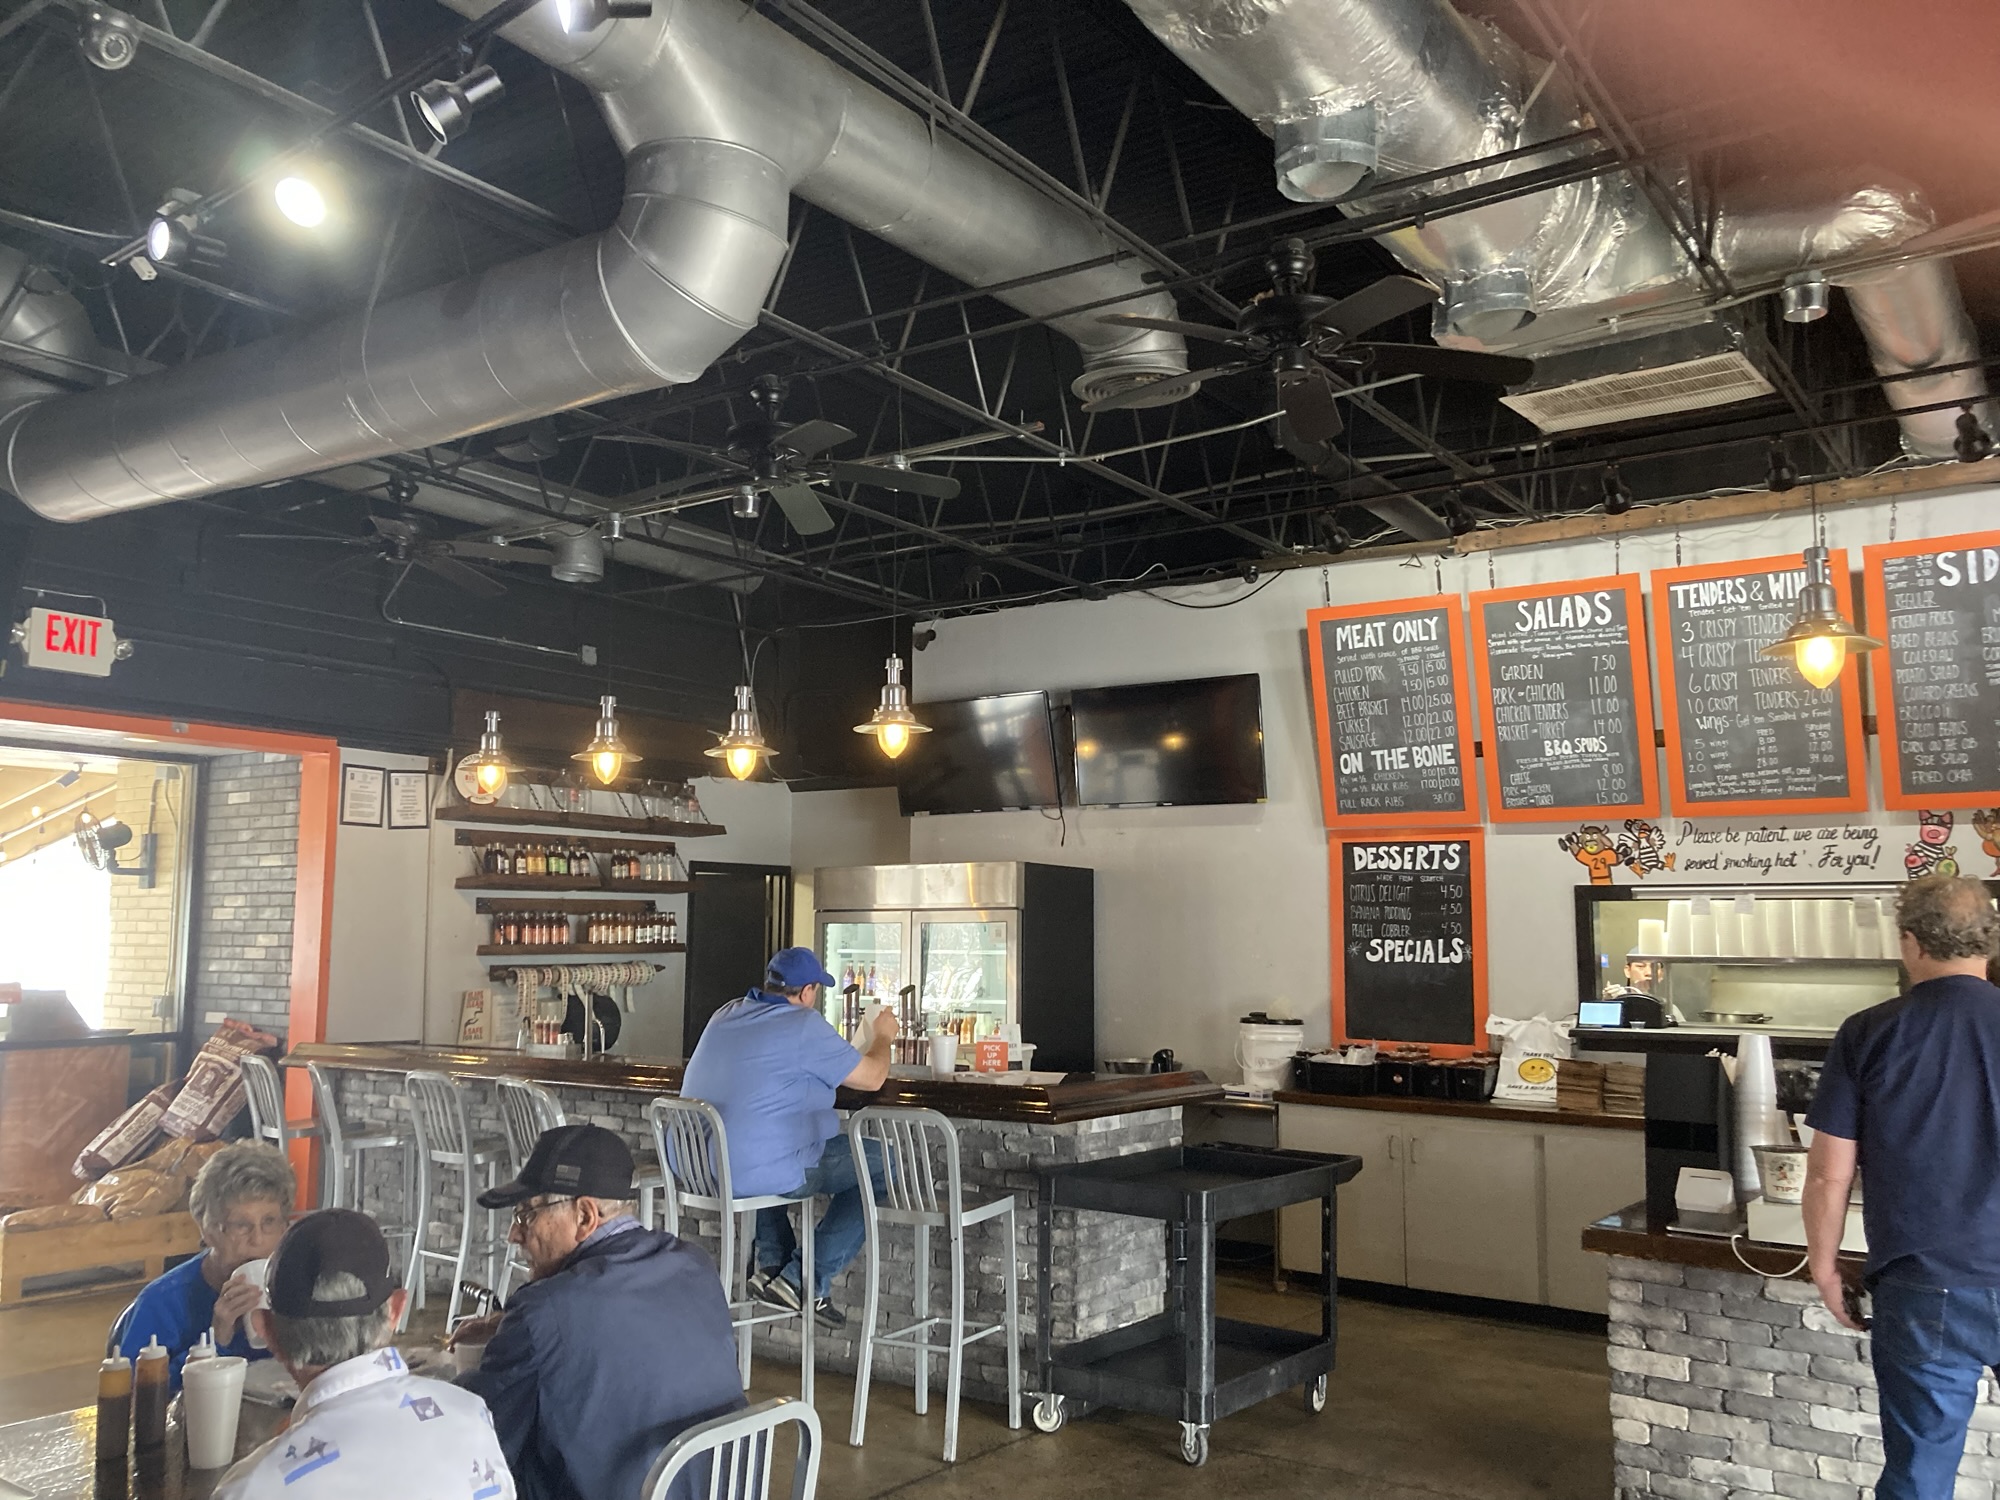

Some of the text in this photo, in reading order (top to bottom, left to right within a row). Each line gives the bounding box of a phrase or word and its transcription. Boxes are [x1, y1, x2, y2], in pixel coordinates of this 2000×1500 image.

[1670, 578, 1747, 609] TENDERS
[1750, 580, 1764, 601] &
[1515, 592, 1612, 632] SALADS
[45, 614, 102, 657] EXIT
[1336, 616, 1438, 651] MEAT ONLY
[1681, 613, 1793, 642] 3 CRISPY TENDERS
[1681, 640, 1737, 668] 4 CRISPY
[1335, 667, 1362, 684] PULLED
[1365, 665, 1385, 682] PORK
[1501, 654, 1616, 681] GARDEN 7.50
[1688, 667, 1792, 693] 6 CRISPY TENDERS
[1333, 685, 1369, 703] CHICKEN
[1493, 687, 1516, 705] PORK
[1526, 682, 1565, 702] CHICKEN
[1687, 698, 1704, 714] 10
[1707, 695, 1739, 712] CRISPY
[1753, 691, 1800, 710] TENDERS
[1336, 702, 1355, 720] BEEF
[1358, 699, 1388, 716] BRISKET
[1495, 704, 1531, 724] CHICKEN
[1533, 702, 1569, 721] TENDERS
[1336, 716, 1370, 735] TURKEY
[1497, 723, 1530, 742] BRISKET
[1538, 720, 1566, 739] TURKEY
[1339, 732, 1379, 751] SAUSAGE
[1544, 736, 1608, 756] BBQ SPUDS
[1695, 738, 1705, 749] 5
[1709, 740, 1729, 748] wings
[1340, 744, 1456, 775] ON THE BONE
[1688, 751, 1704, 761] 10
[1710, 751, 1729, 759] wings
[1374, 772, 1405, 781] CHICKEN
[1510, 771, 1531, 786] CHEESE
[1688, 763, 1706, 773] 20
[1371, 783, 1389, 792] RACK
[1393, 782, 1409, 791] RIBS
[1340, 799, 1356, 809] FULL
[1361, 797, 1381, 807] RACK
[1385, 796, 1404, 807] RIBS
[1676, 820, 1722, 846] Please
[1726, 827, 1740, 843] be
[1793, 830, 1812, 842] we
[1817, 828, 1838, 841] are
[1842, 824, 1879, 849] being
[1353, 843, 1461, 871] DESSERTS
[1591, 858, 1607, 870] 29
[1684, 853, 1718, 871] served
[1818, 844, 1843, 868] For
[1843, 845, 1881, 875] you!
[1349, 884, 1375, 902] CITRUS
[1379, 885, 1413, 902] DELIGHT
[1350, 905, 1380, 919] BANANA
[1384, 905, 1412, 920] PUDDING
[1352, 924, 1373, 938] PEACH
[1381, 923, 1411, 937] COBBLER
[1365, 937, 1464, 964] SPECIALS
[1773, 1184, 1800, 1193] TIPS
